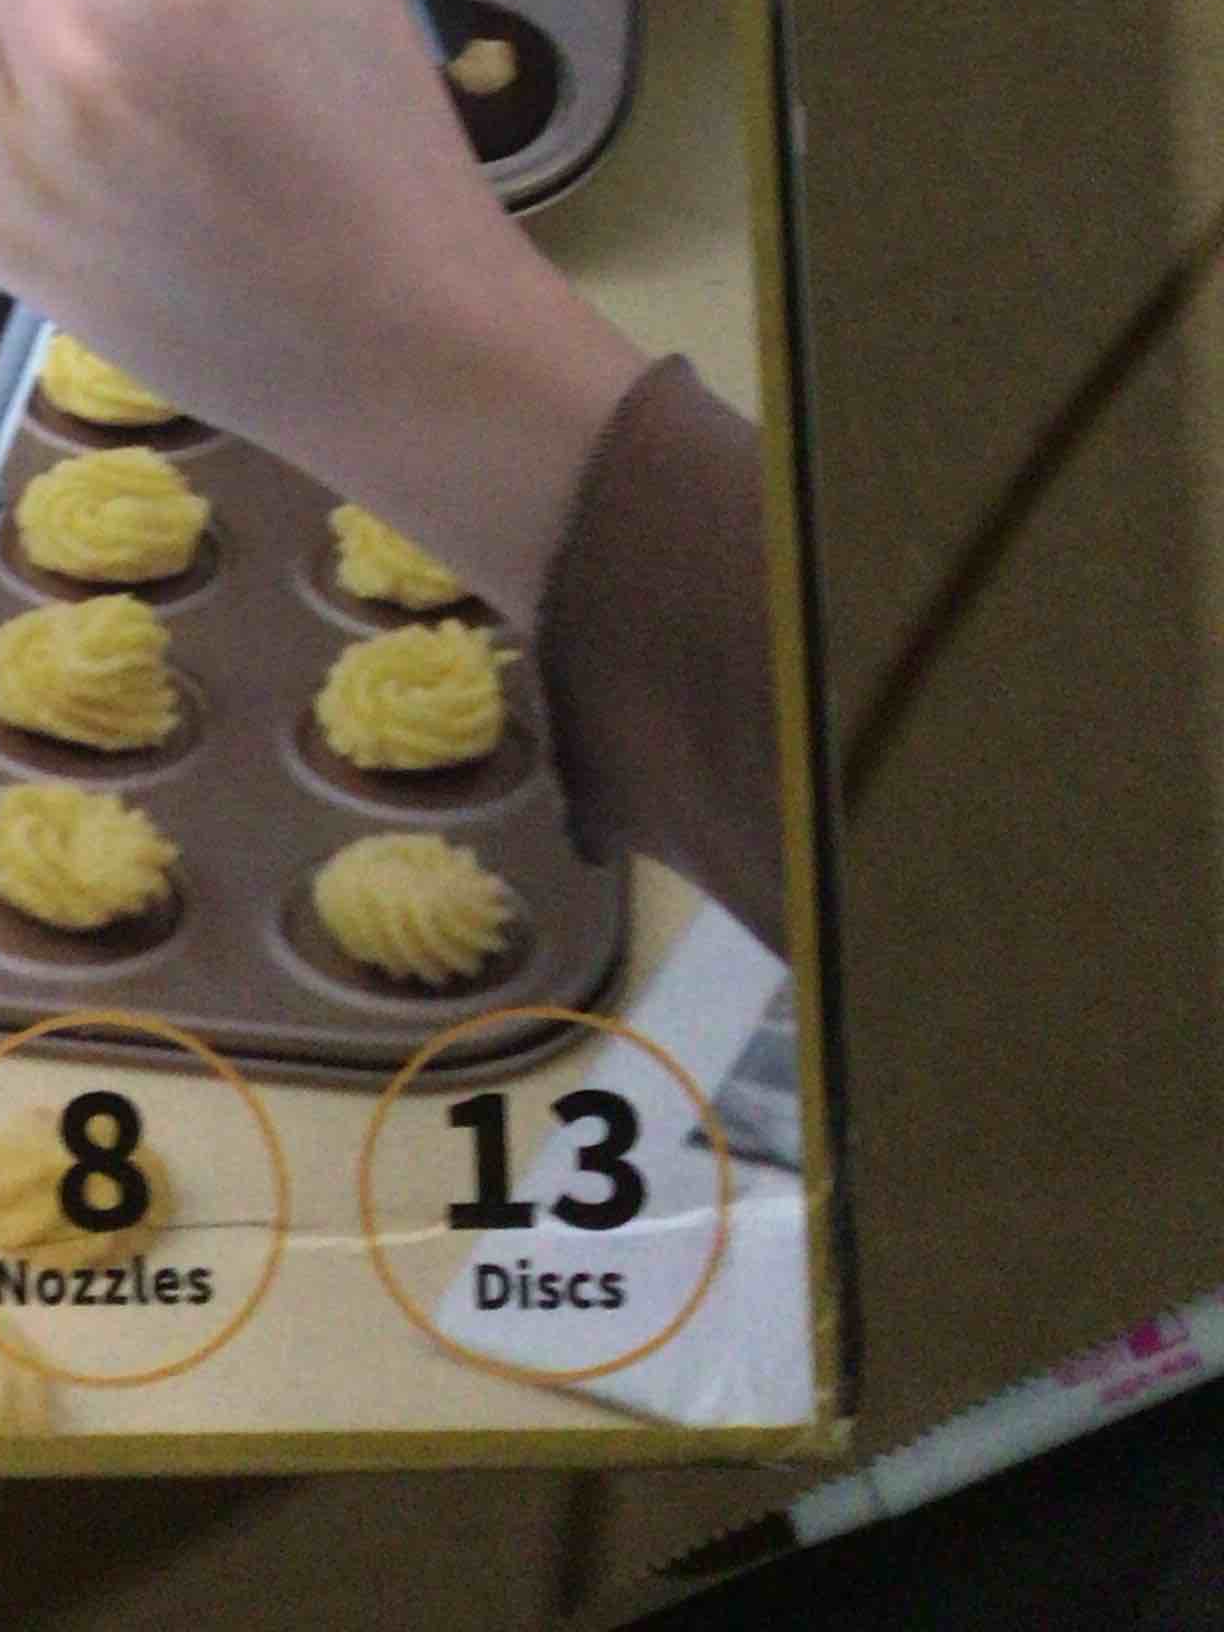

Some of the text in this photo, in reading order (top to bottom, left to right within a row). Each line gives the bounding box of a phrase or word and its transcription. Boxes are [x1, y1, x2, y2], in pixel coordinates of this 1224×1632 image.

[57, 1090, 152, 1234] 8
[448, 1089, 648, 1232] 13
[475, 1262, 626, 1311] Discs
